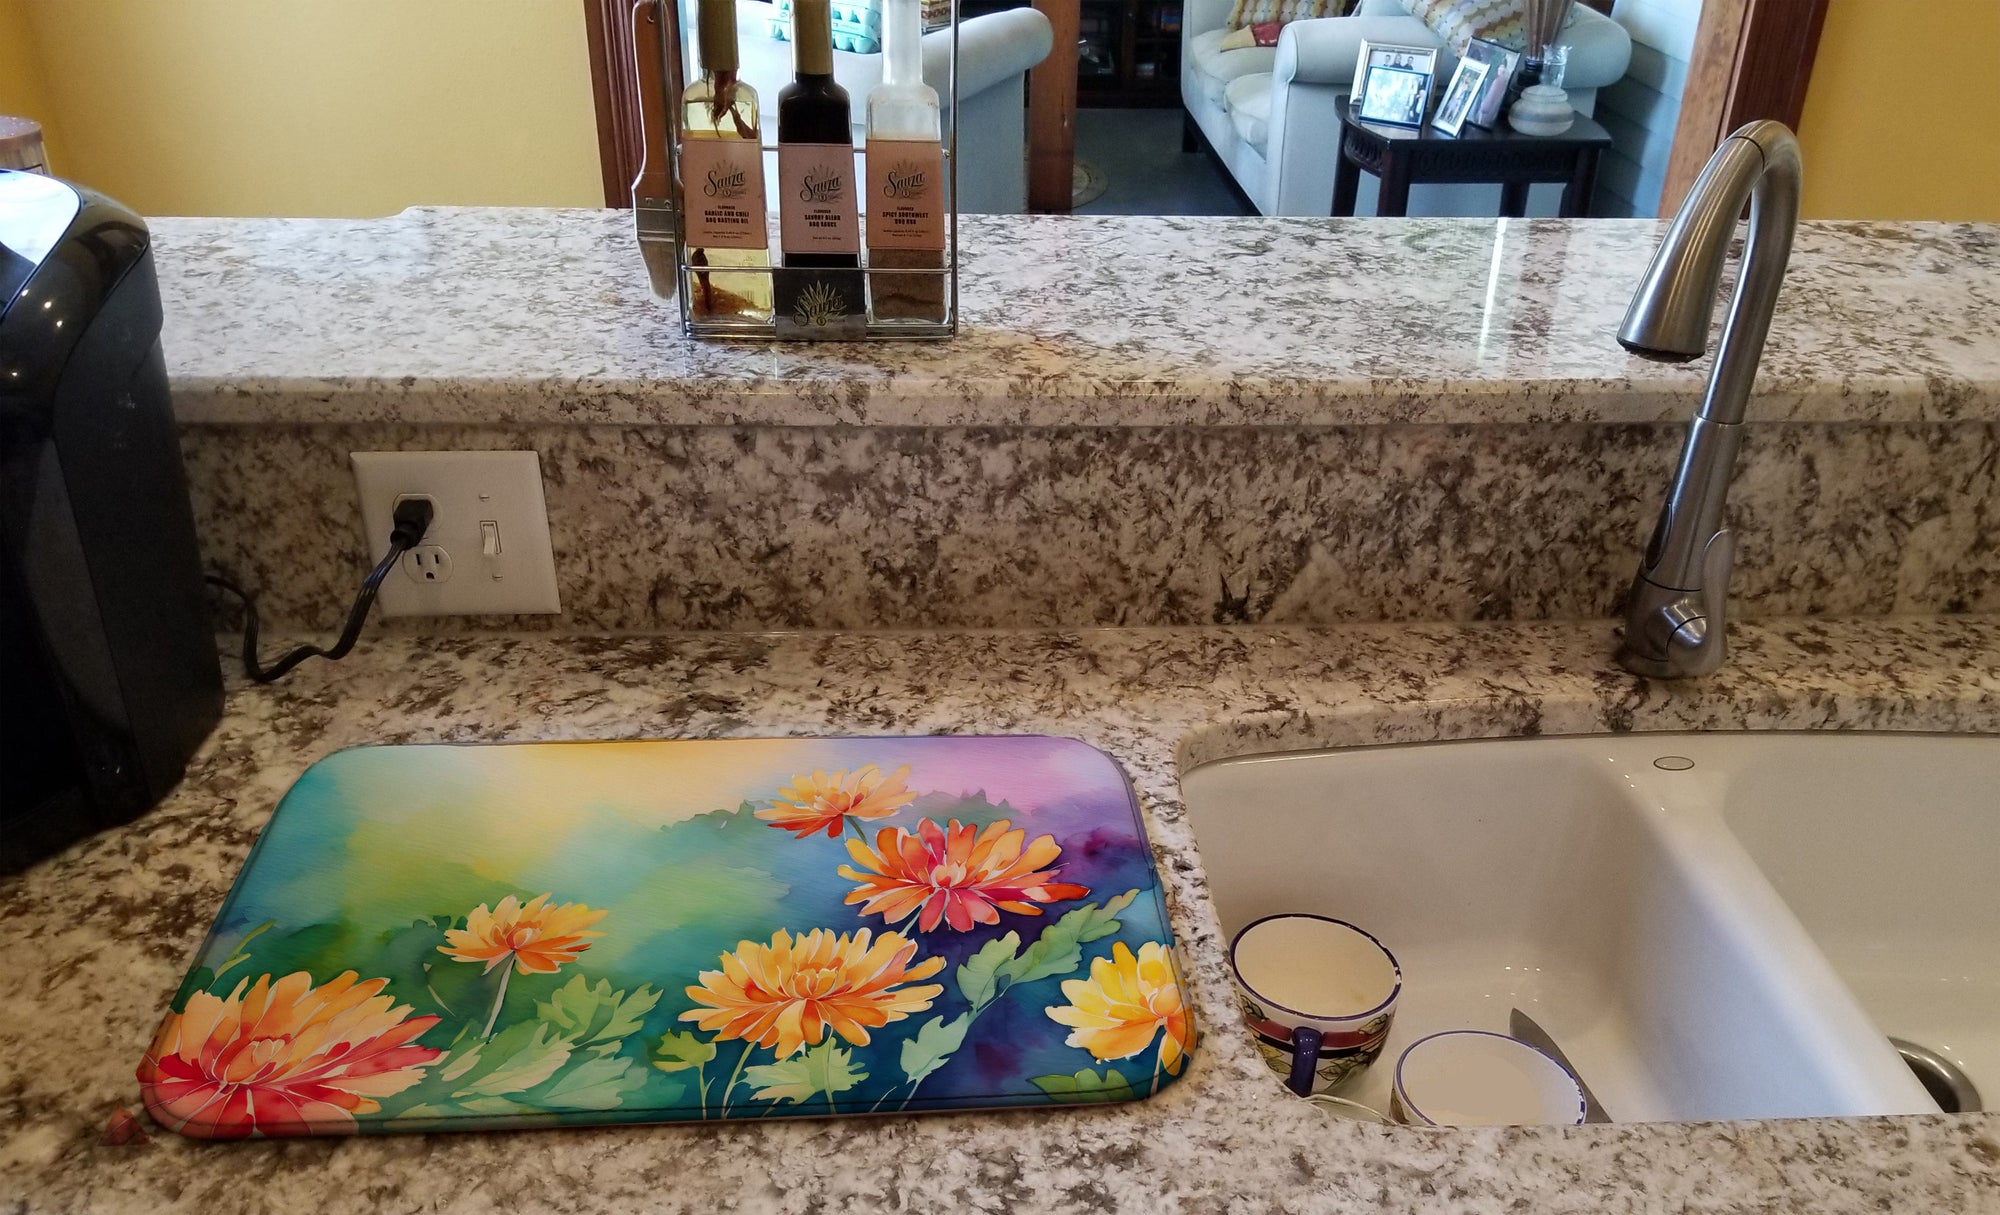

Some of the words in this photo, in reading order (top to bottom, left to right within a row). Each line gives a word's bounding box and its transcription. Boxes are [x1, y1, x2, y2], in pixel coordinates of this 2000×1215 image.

[704, 169, 745, 197] Sauza
[800, 175, 841, 202] Sauza
[884, 171, 925, 198] Sauza
